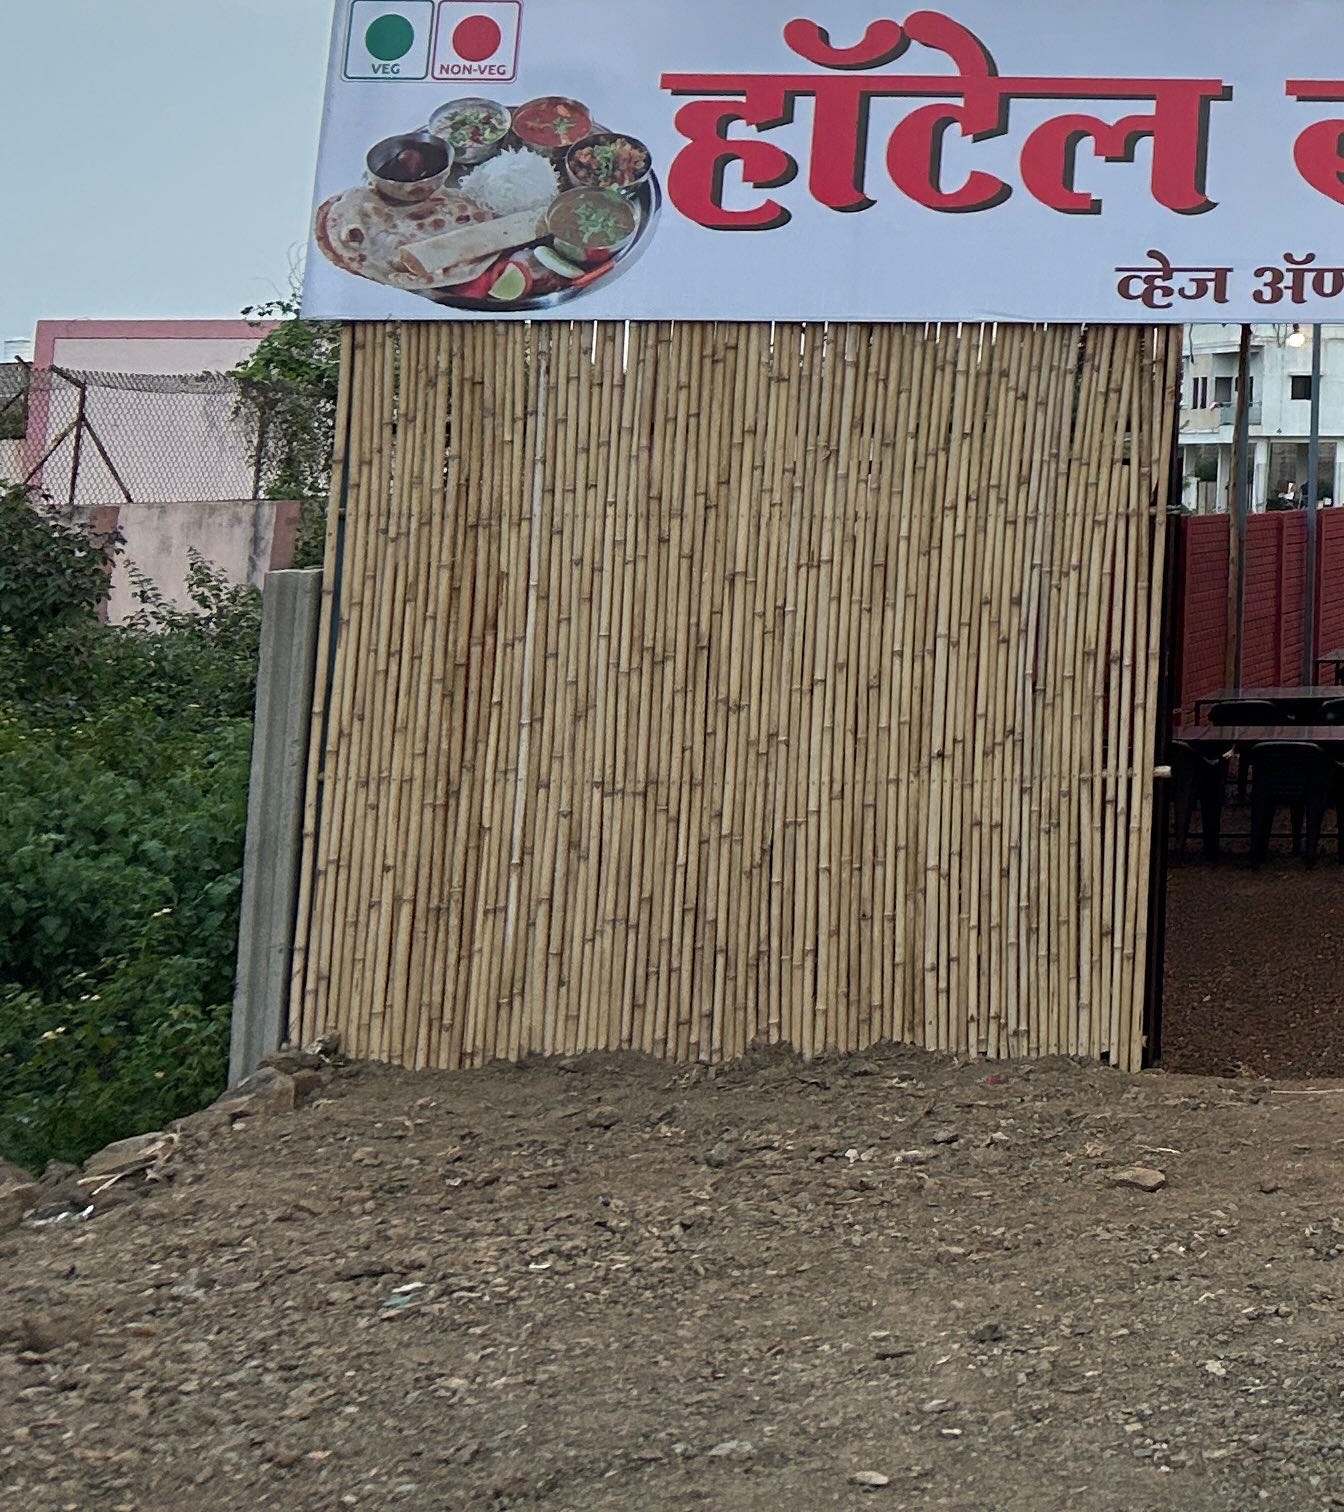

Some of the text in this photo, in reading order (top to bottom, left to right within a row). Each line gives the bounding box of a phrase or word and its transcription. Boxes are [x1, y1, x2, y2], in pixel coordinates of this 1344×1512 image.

[371, 63, 401, 75] VEG
[439, 64, 507, 76] NON-VEG
[660, 10, 1232, 231] हॉटेल
[1114, 249, 1234, 309] व्हेज
